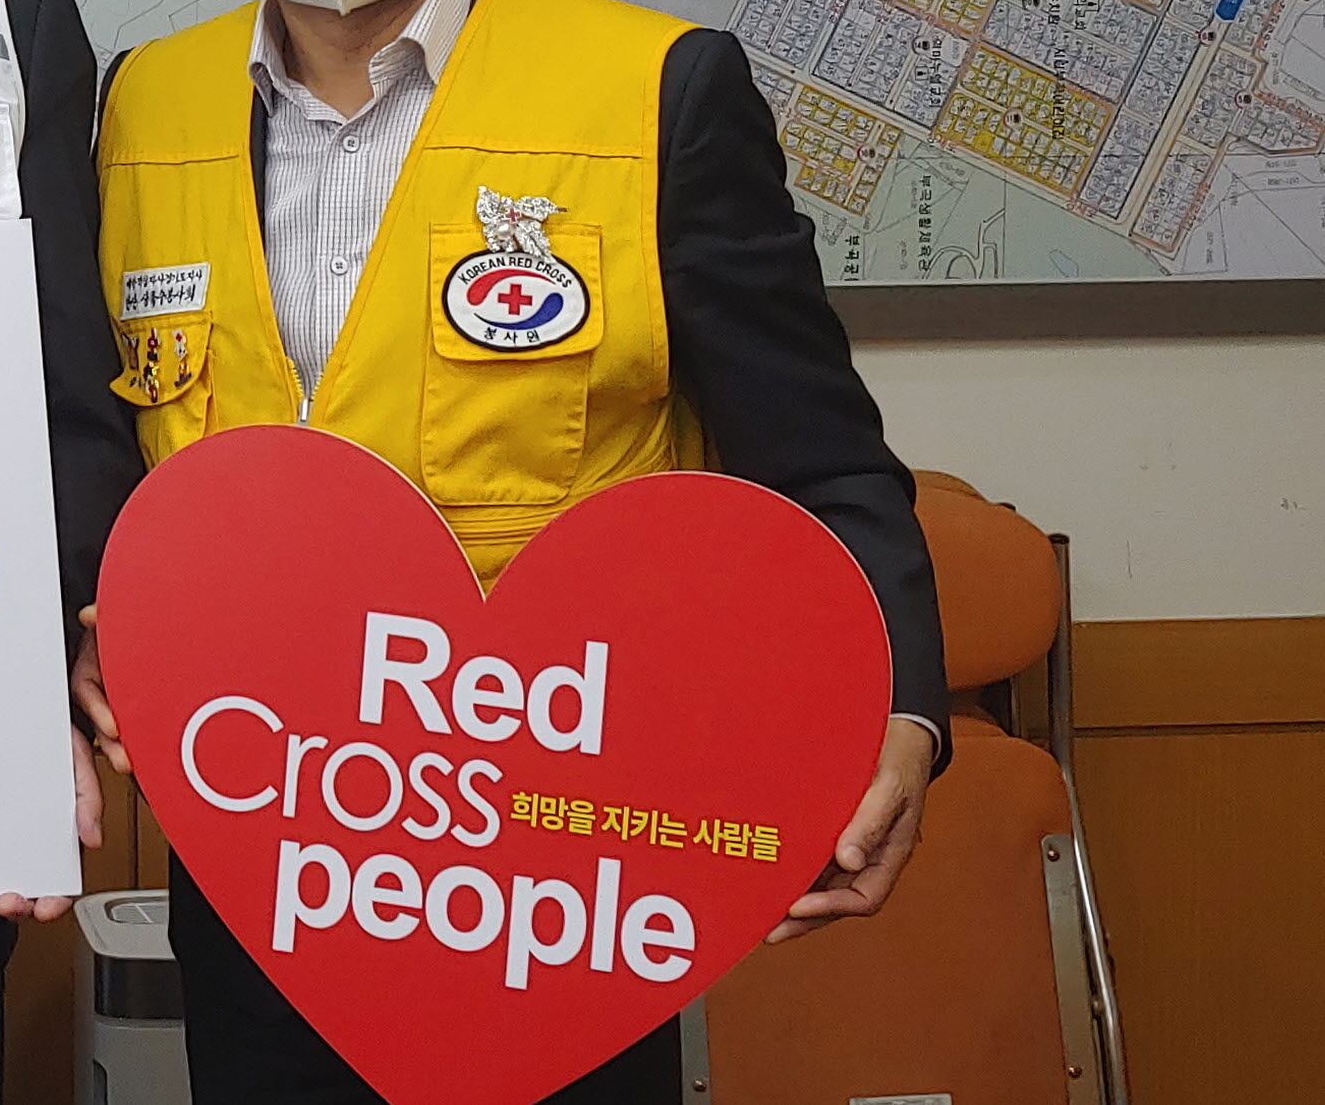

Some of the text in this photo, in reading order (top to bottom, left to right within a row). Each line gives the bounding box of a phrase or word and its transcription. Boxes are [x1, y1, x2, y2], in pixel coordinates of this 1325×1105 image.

[458, 257, 572, 288] KOREAN RED CROSS
[359, 611, 608, 756] Red
[181, 695, 503, 848] Cross
[511, 791, 781, 862] 희망을 지키는 사람들
[271, 838, 695, 990] people
